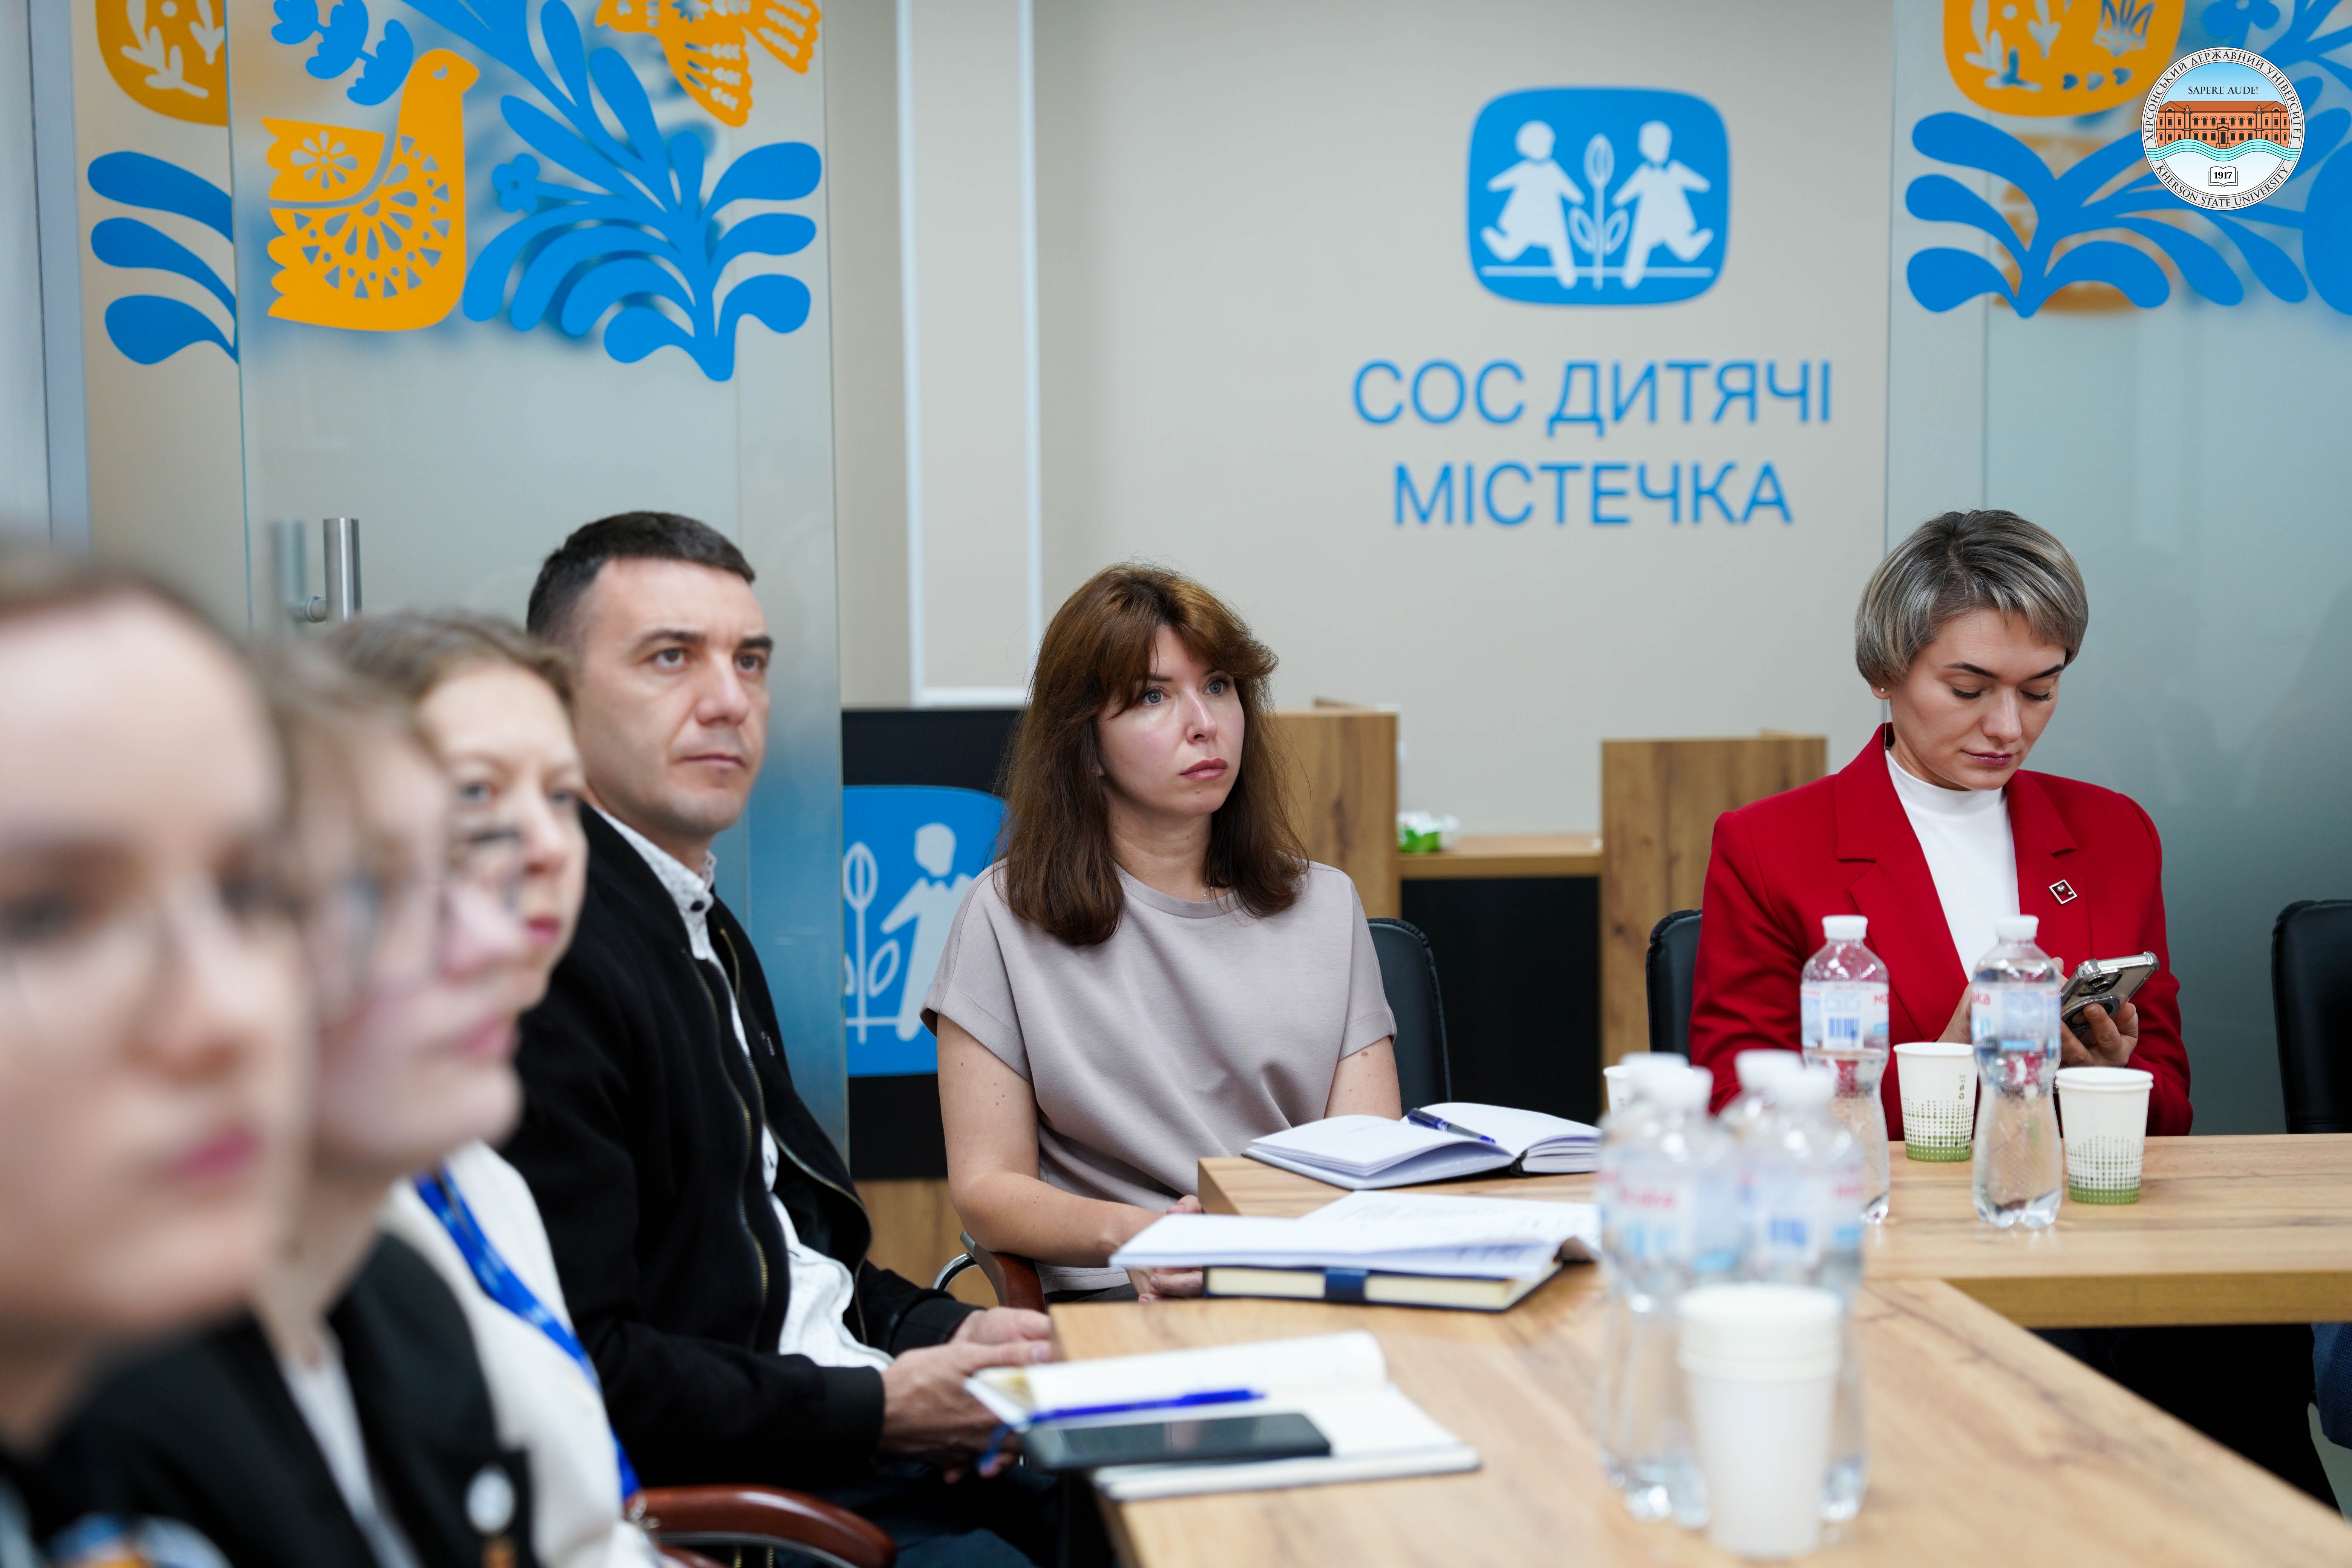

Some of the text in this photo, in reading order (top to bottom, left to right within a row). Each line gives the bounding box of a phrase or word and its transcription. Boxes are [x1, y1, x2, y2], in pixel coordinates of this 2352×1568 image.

[1352, 358, 1832, 439] СОС ДИТЯЧІ
[1393, 460, 1795, 527] МІСТЕЧКА
